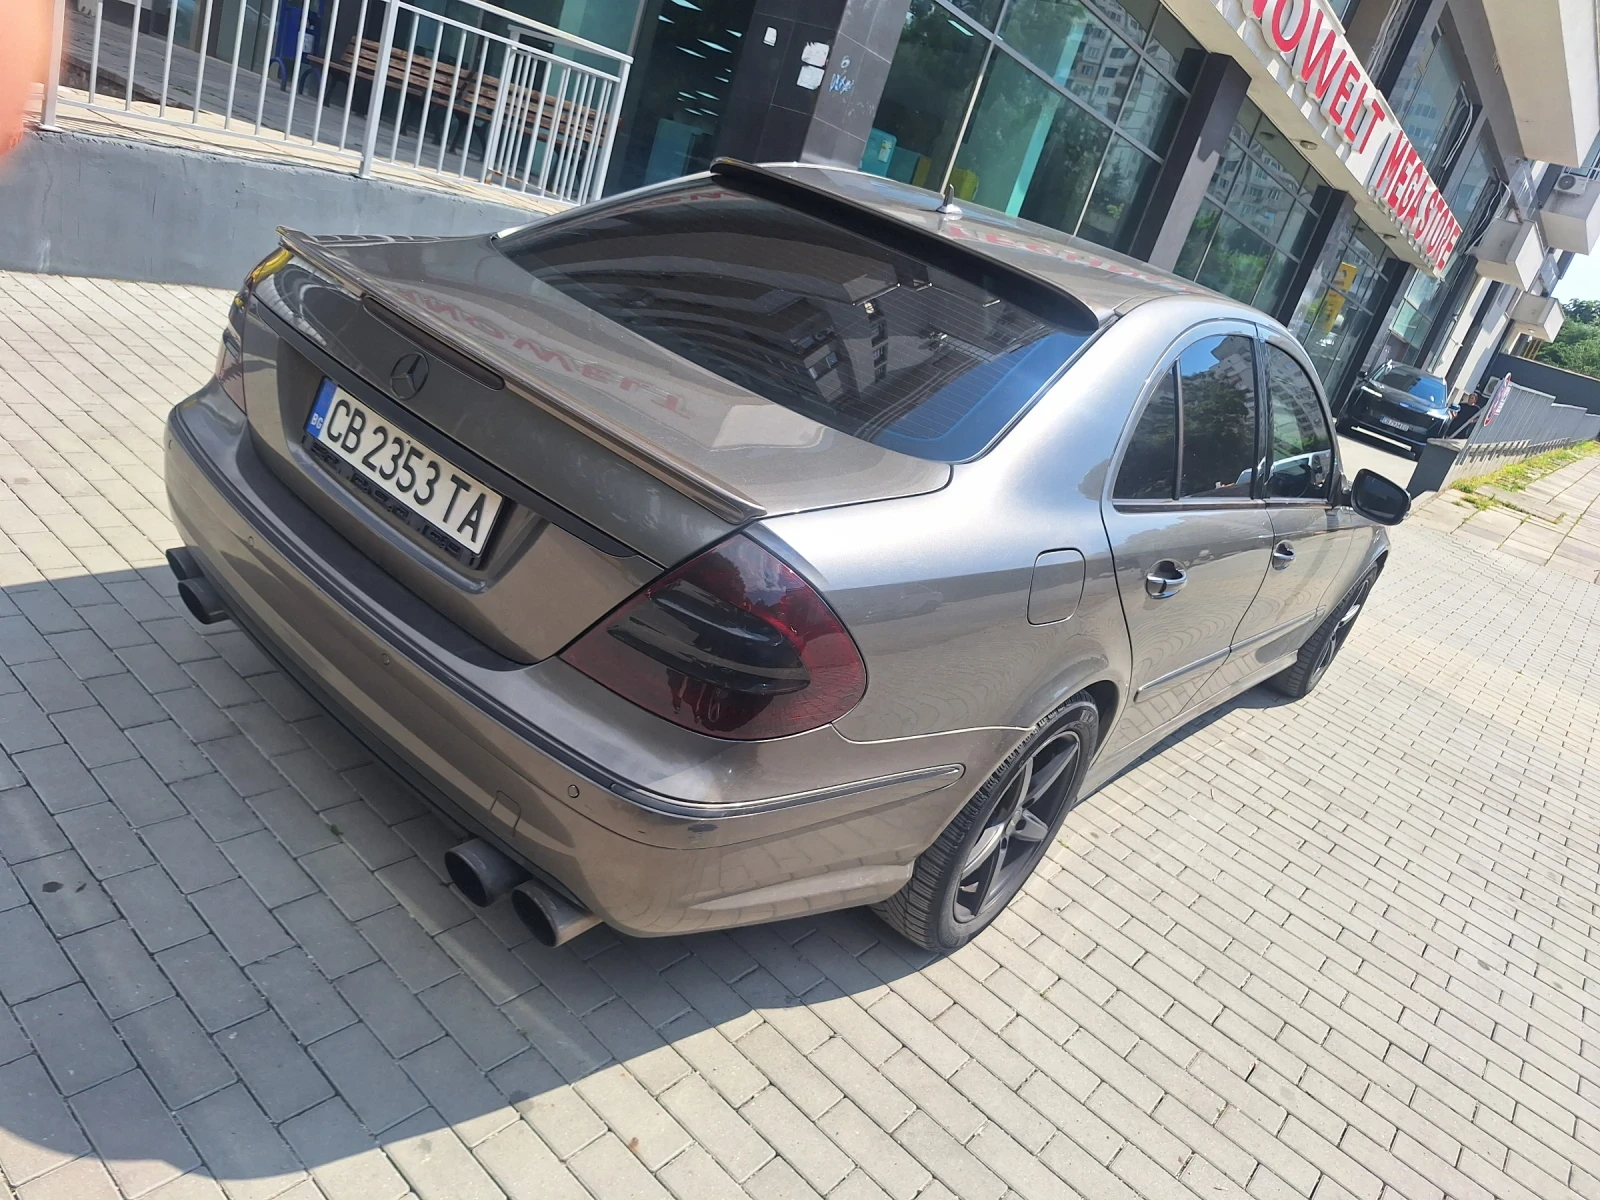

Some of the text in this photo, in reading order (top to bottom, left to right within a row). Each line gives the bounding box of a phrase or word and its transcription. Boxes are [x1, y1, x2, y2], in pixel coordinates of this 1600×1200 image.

[1252, 0, 1385, 154] OWELT
[310, 412, 324, 429] BG
[326, 399, 487, 543] CB 2353 TA
